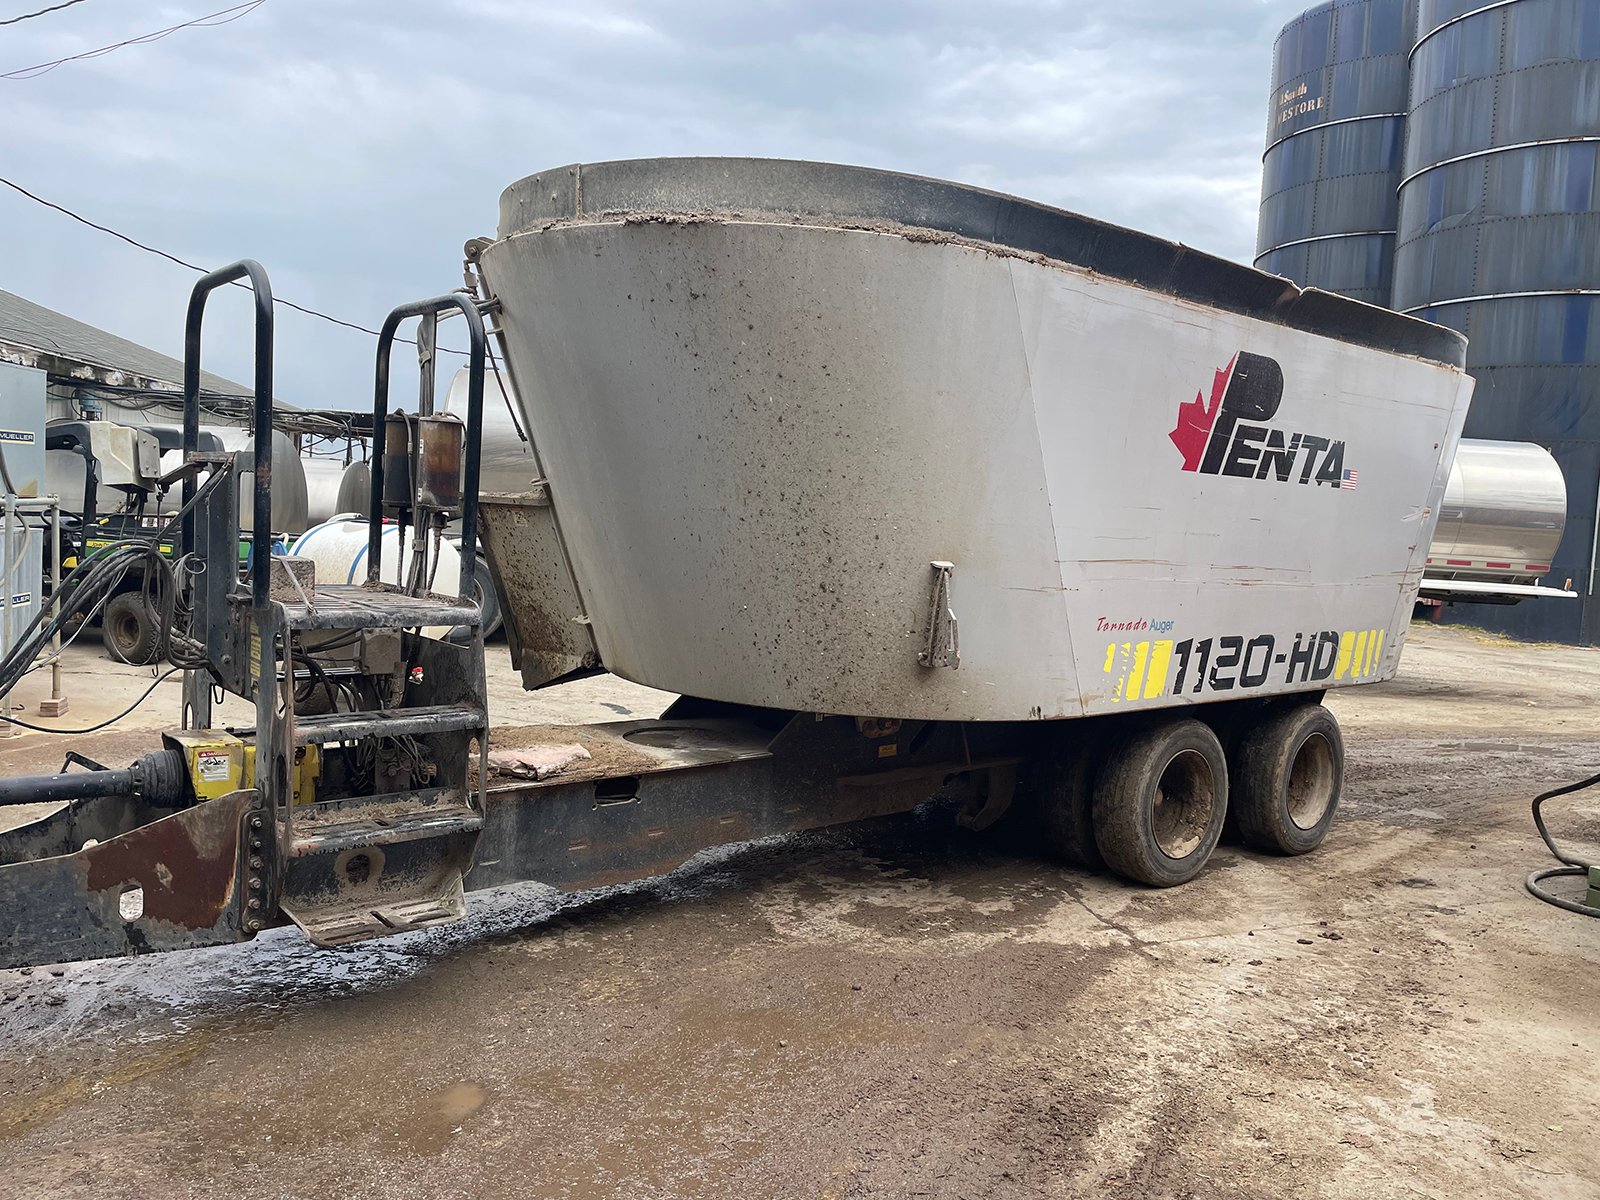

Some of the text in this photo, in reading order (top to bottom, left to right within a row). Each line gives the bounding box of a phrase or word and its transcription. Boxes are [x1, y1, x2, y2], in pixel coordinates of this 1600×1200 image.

[1200, 351, 1345, 488] PENTA
[1097, 616, 1174, 634] Tornado Auger
[1173, 631, 1339, 694] 1120-HD
